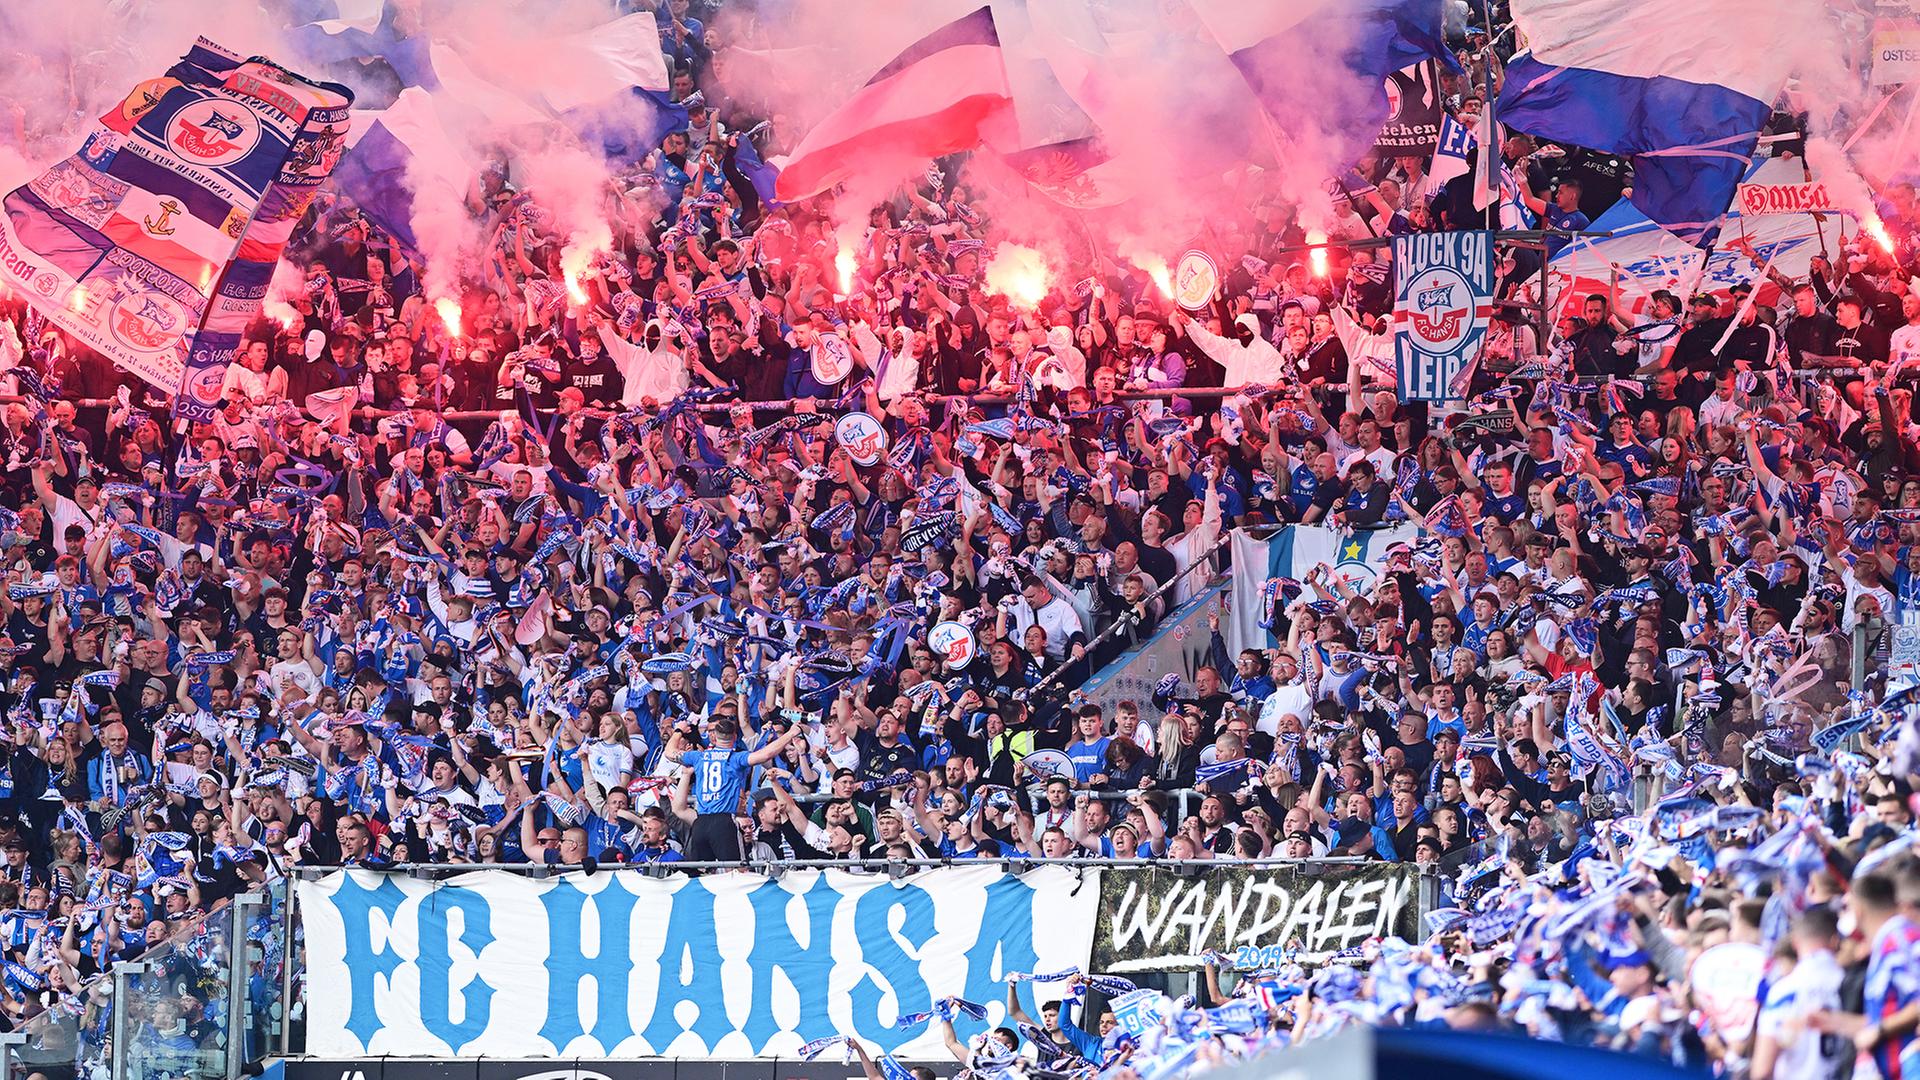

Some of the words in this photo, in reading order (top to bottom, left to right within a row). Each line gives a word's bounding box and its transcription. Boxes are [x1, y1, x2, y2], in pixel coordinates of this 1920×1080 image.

[1882, 49, 1920, 62] OSTSE
[1745, 183, 1831, 212] Hansa
[1396, 231, 1459, 300] BLOCK
[1461, 231, 1487, 294] 9A
[1482, 417, 1514, 430] HANS
[701, 760, 722, 793] 18
[1111, 873, 1411, 955] WANDALEN
[329, 869, 498, 1056] FC
[537, 870, 1041, 1056] HANSA
[1235, 945, 1284, 969] 2019
